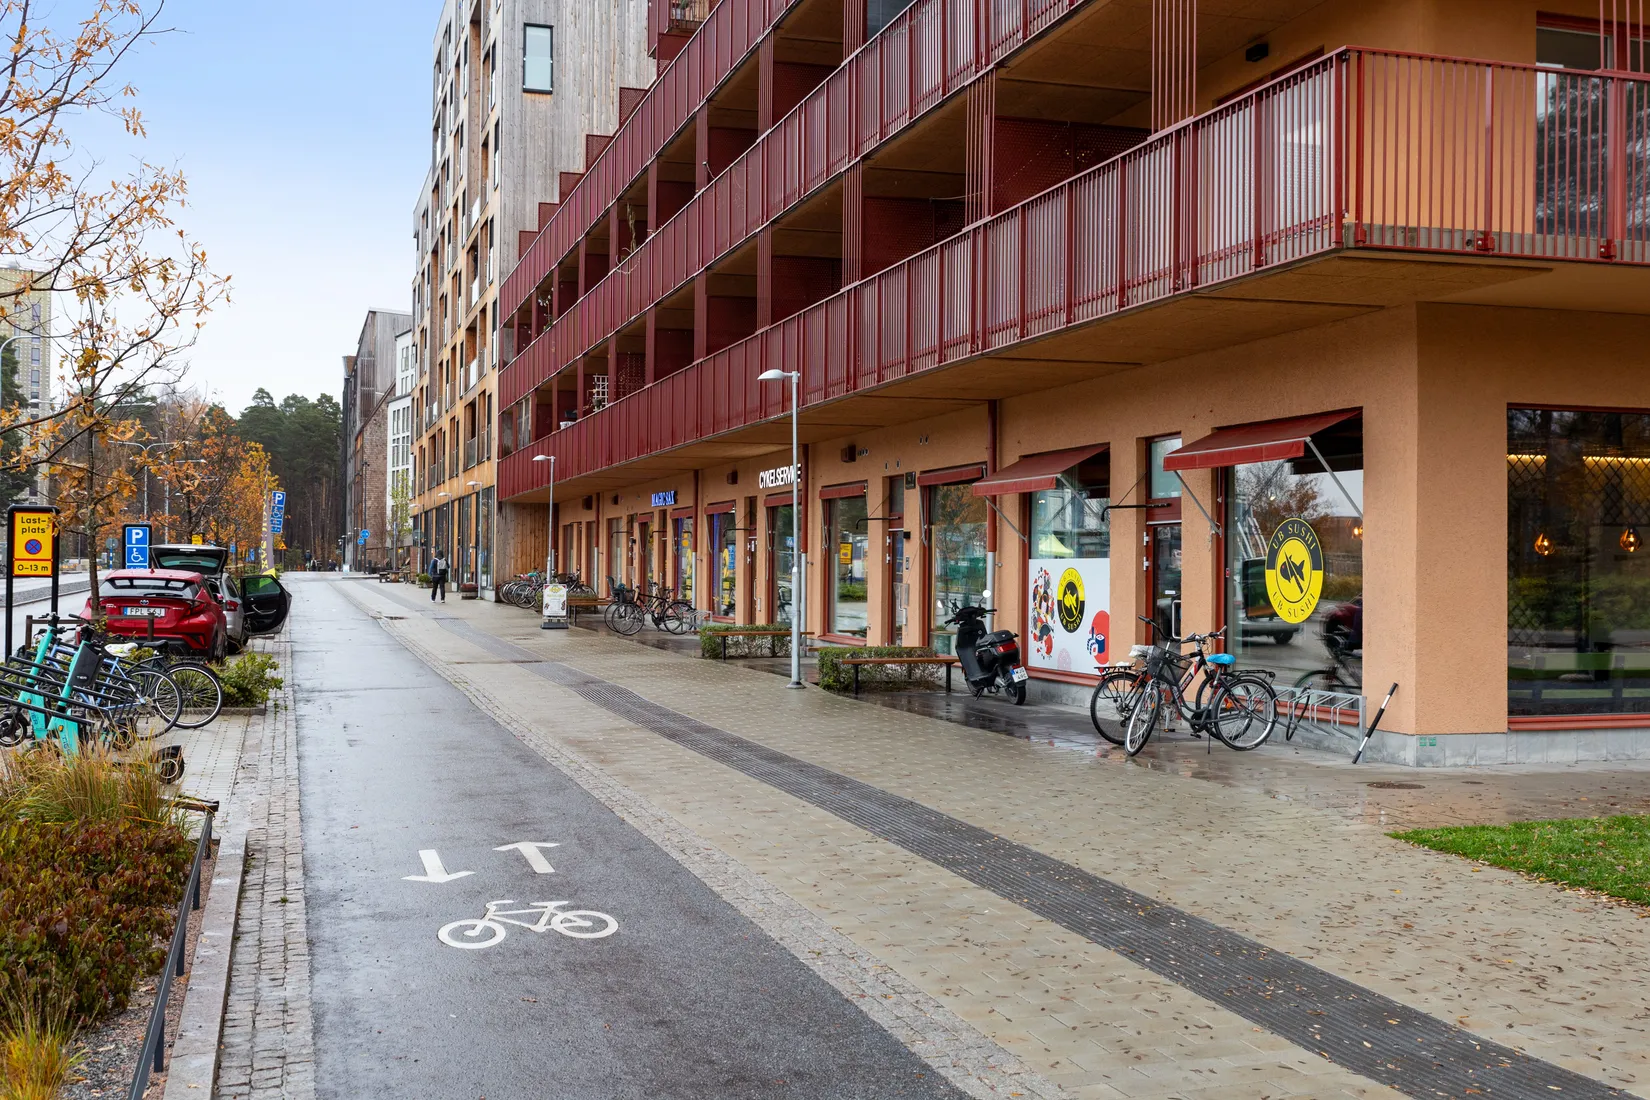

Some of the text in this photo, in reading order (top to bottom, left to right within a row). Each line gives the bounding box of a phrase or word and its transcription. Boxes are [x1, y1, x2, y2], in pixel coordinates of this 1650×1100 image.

[759, 463, 801, 489] CYKELSERVIE
[275, 493, 283, 504] P
[21, 516, 46, 524] Last-
[21, 526, 46, 535] plats
[131, 529, 144, 544] P
[1272, 523, 1316, 549] UB SUSHI
[129, 607, 145, 615] FPL
[1272, 591, 1316, 618] UB SUSHI
[1067, 613, 1082, 630] SUSHI
